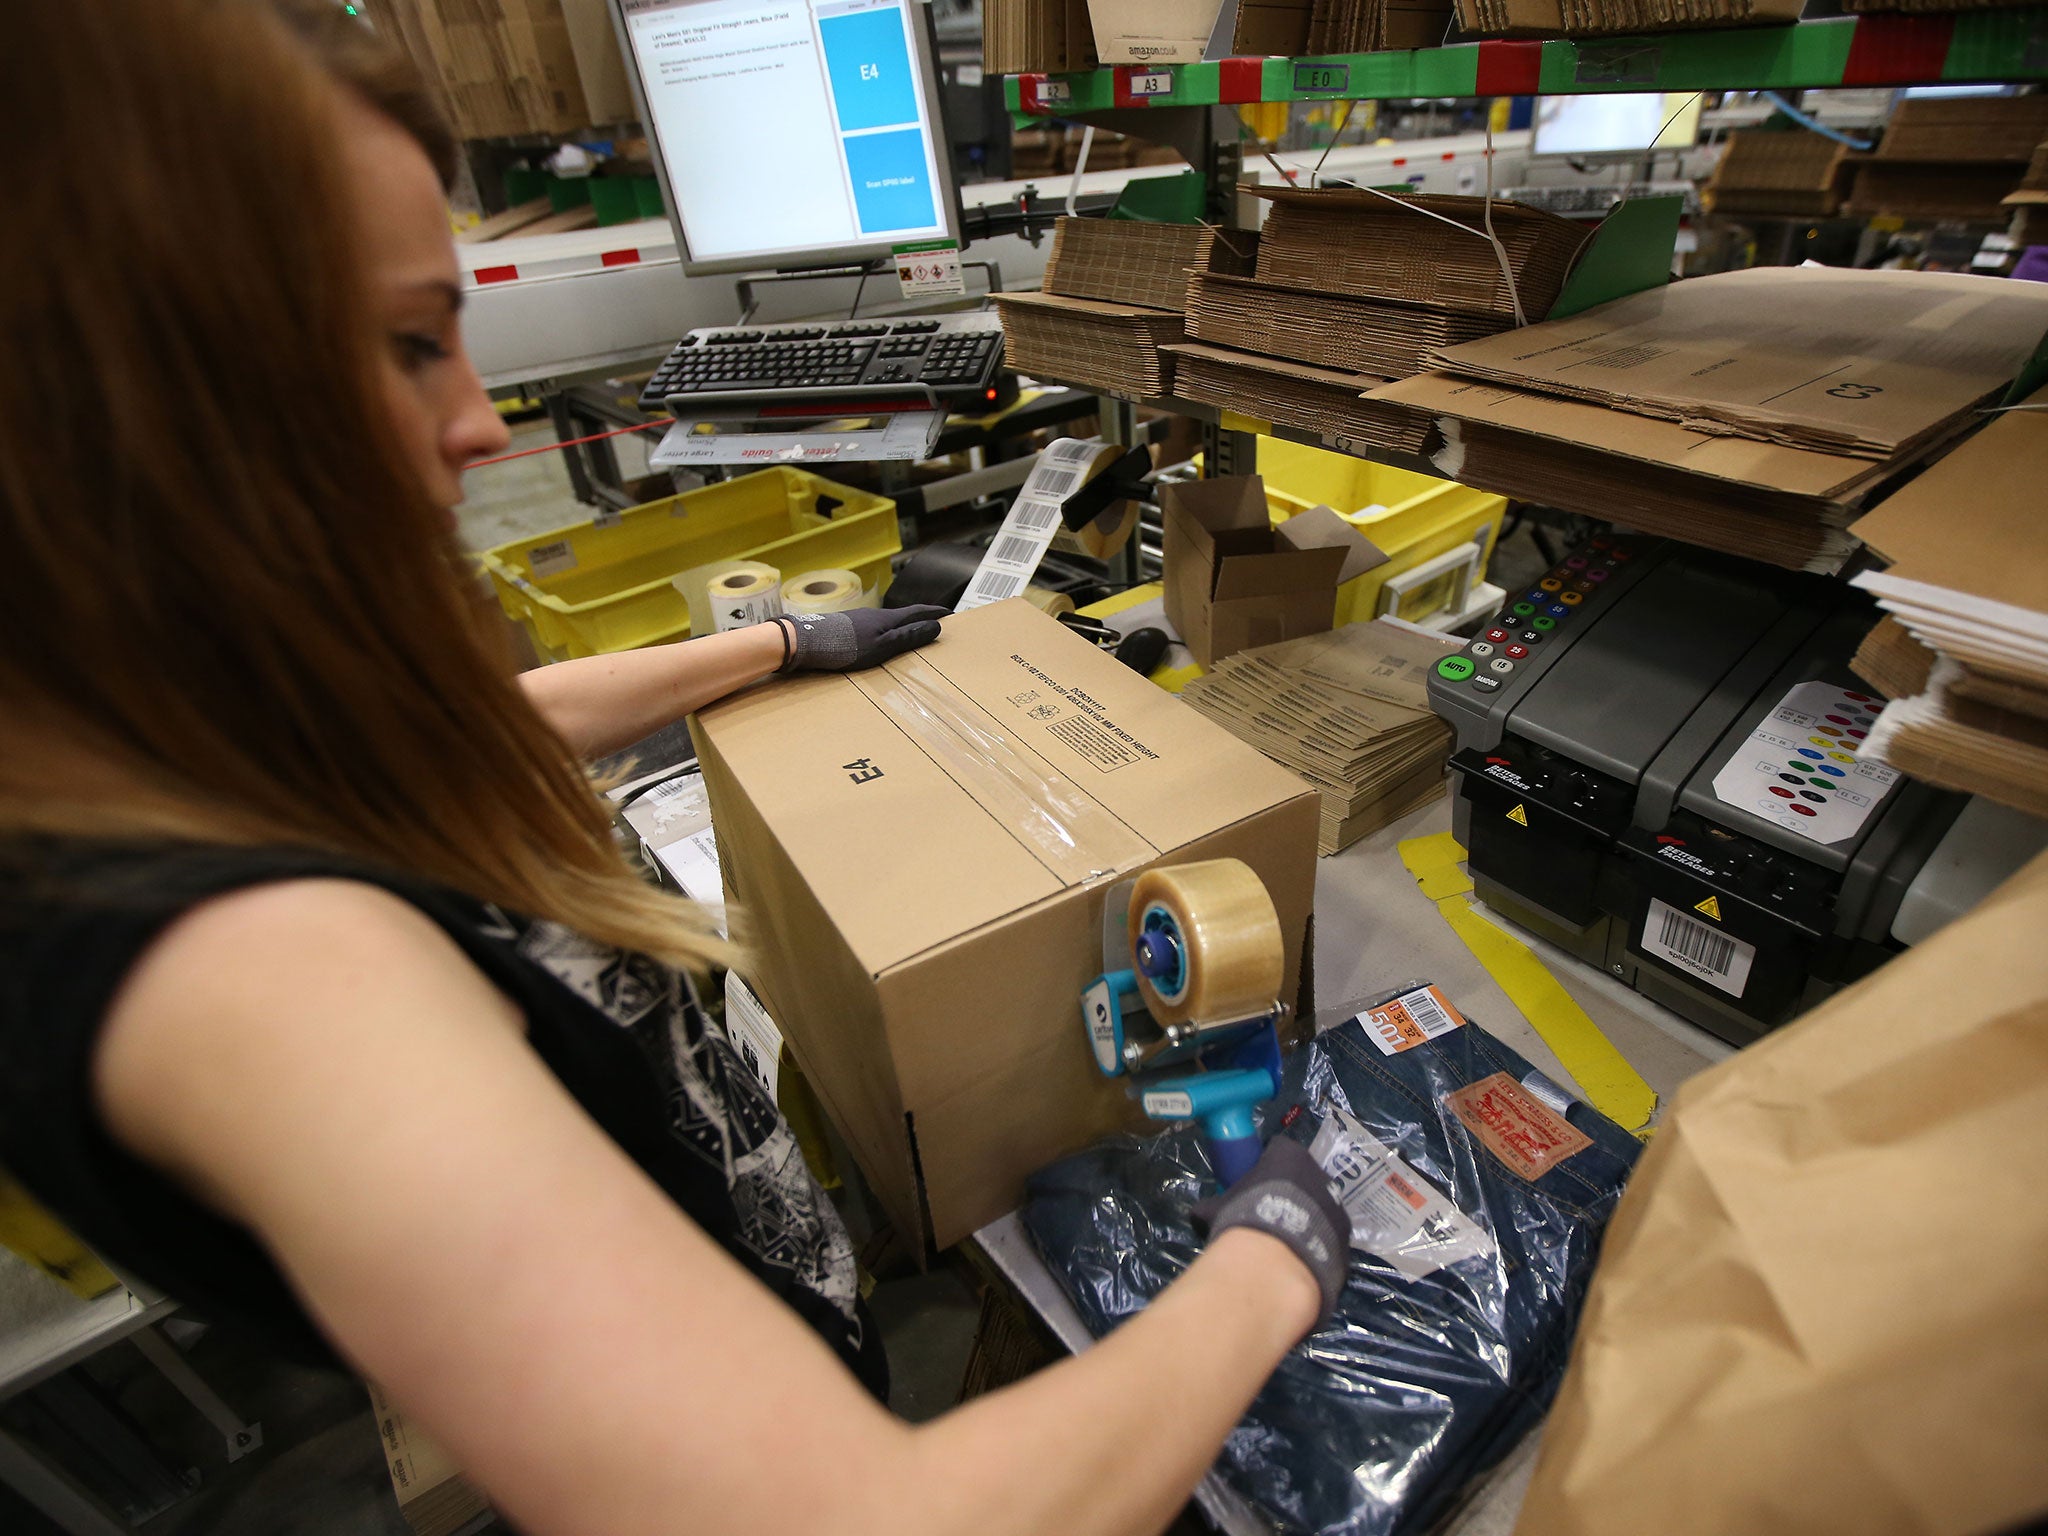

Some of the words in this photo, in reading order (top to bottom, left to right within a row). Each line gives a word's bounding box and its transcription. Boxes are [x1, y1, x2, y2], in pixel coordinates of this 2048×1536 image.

[1128, 45, 1178, 56] amazon.co.uk
[860, 63, 879, 80] E4
[1144, 78, 1158, 92] A3
[1826, 383, 1883, 399] C3
[741, 448, 773, 459] Guide
[1505, 616, 1517, 625] 35
[1490, 630, 1503, 638] 25
[1524, 631, 1537, 640] 35
[1477, 645, 1488, 653] 15
[1510, 646, 1523, 654] 25
[1444, 661, 1467, 673] AUTO
[1496, 661, 1508, 669] 15
[1474, 675, 1499, 687] RANDOM
[1010, 654, 1024, 665] BOX
[1036, 672, 1056, 687] FEFCO
[1100, 719, 1115, 730] MM
[1111, 727, 1134, 743] FIXED
[1131, 740, 1161, 760] HEIGHT
[842, 758, 885, 785] E4
[1484, 767, 1531, 791] PACKAGES
[1491, 764, 1522, 781] BETTER
[1657, 848, 1716, 877] PACKAGES
[1663, 844, 1703, 864] BETTER
[1369, 1011, 1408, 1046] 501
[1393, 1013, 1405, 1024] 34
[1404, 1027, 1416, 1038] 32
[1496, 1080, 1518, 1099] LEVI
[1517, 1097, 1553, 1128] STRAUSS
[1550, 1126, 1560, 1135] &
